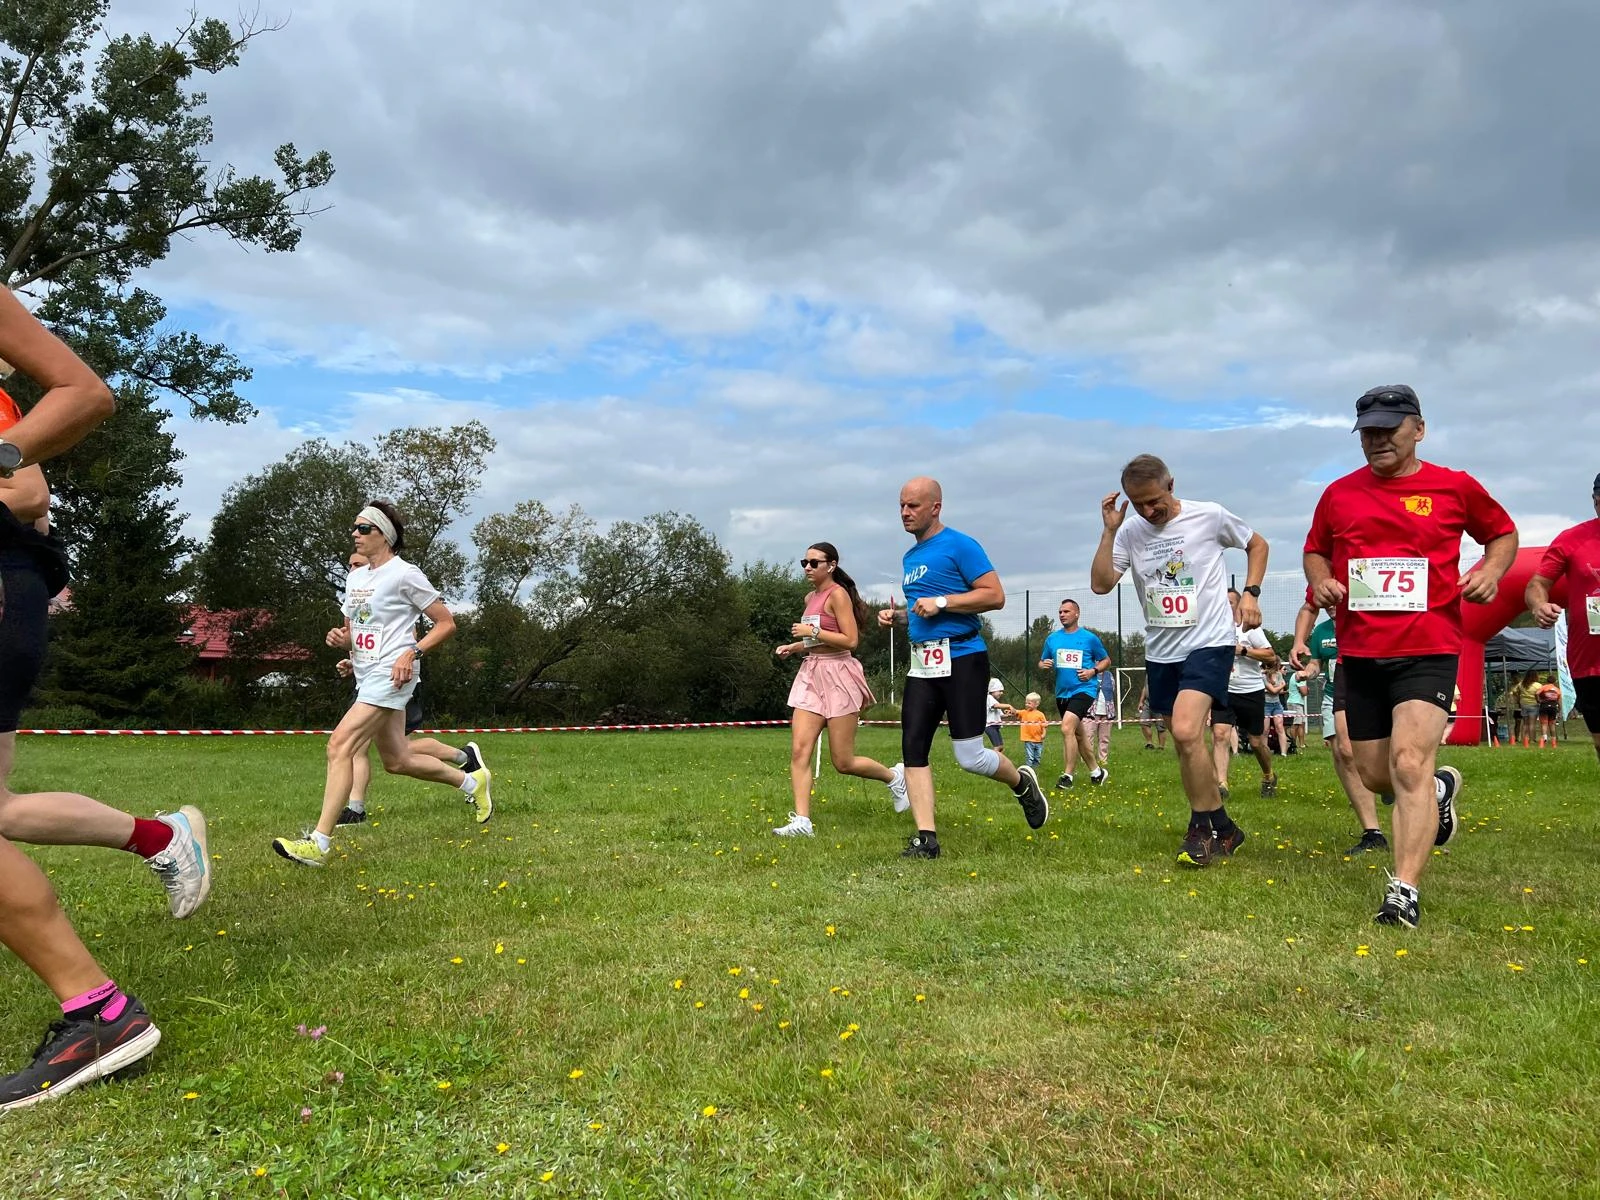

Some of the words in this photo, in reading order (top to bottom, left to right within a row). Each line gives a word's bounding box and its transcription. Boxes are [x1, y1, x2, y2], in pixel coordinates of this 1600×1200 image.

[1378, 571, 1415, 593] 75
[1162, 596, 1188, 614] 90
[356, 633, 375, 650] 46
[923, 648, 944, 666] 79
[1066, 654, 1078, 663] 85
